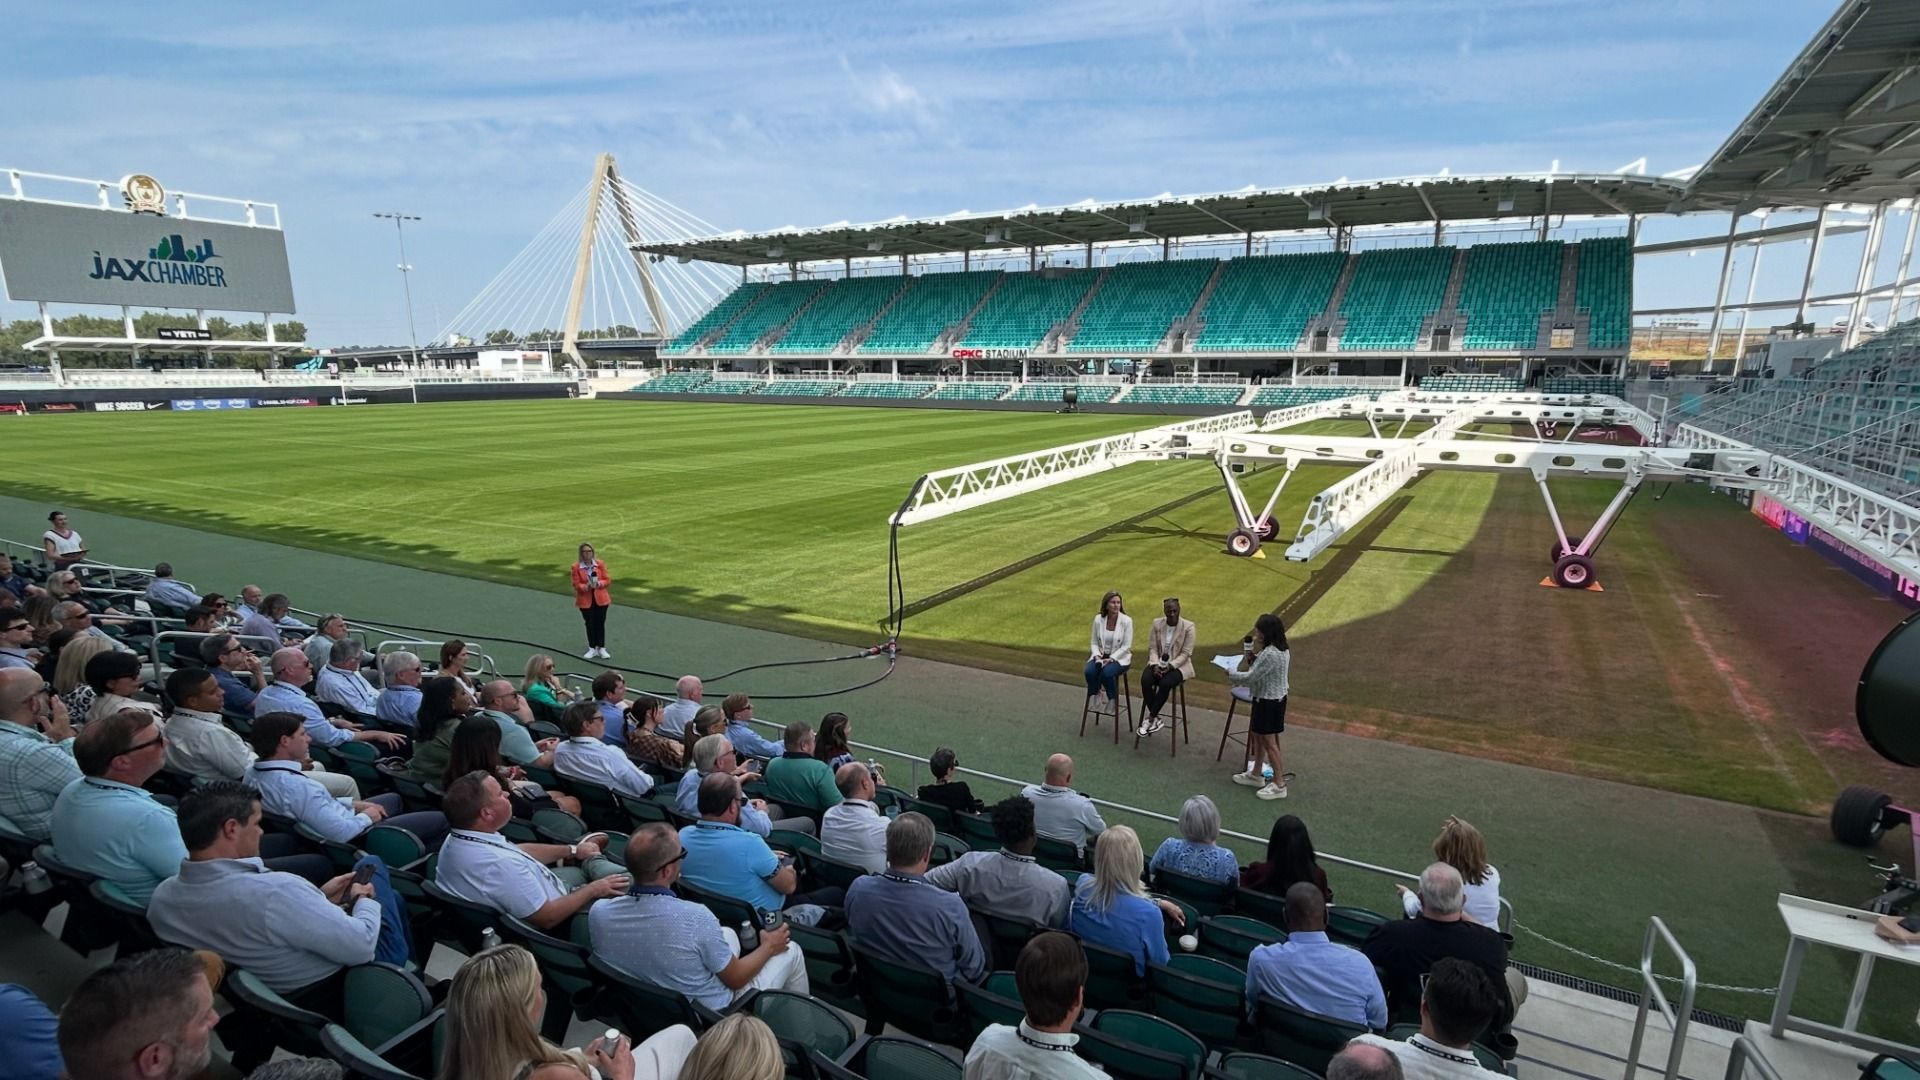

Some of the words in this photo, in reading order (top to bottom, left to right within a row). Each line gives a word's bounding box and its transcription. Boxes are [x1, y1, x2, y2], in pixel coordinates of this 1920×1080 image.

[172, 330, 197, 338] YETI
[953, 350, 983, 358] CPKC
[985, 349, 1028, 359] STADIUM
[115, 401, 145, 411] SOCCER
